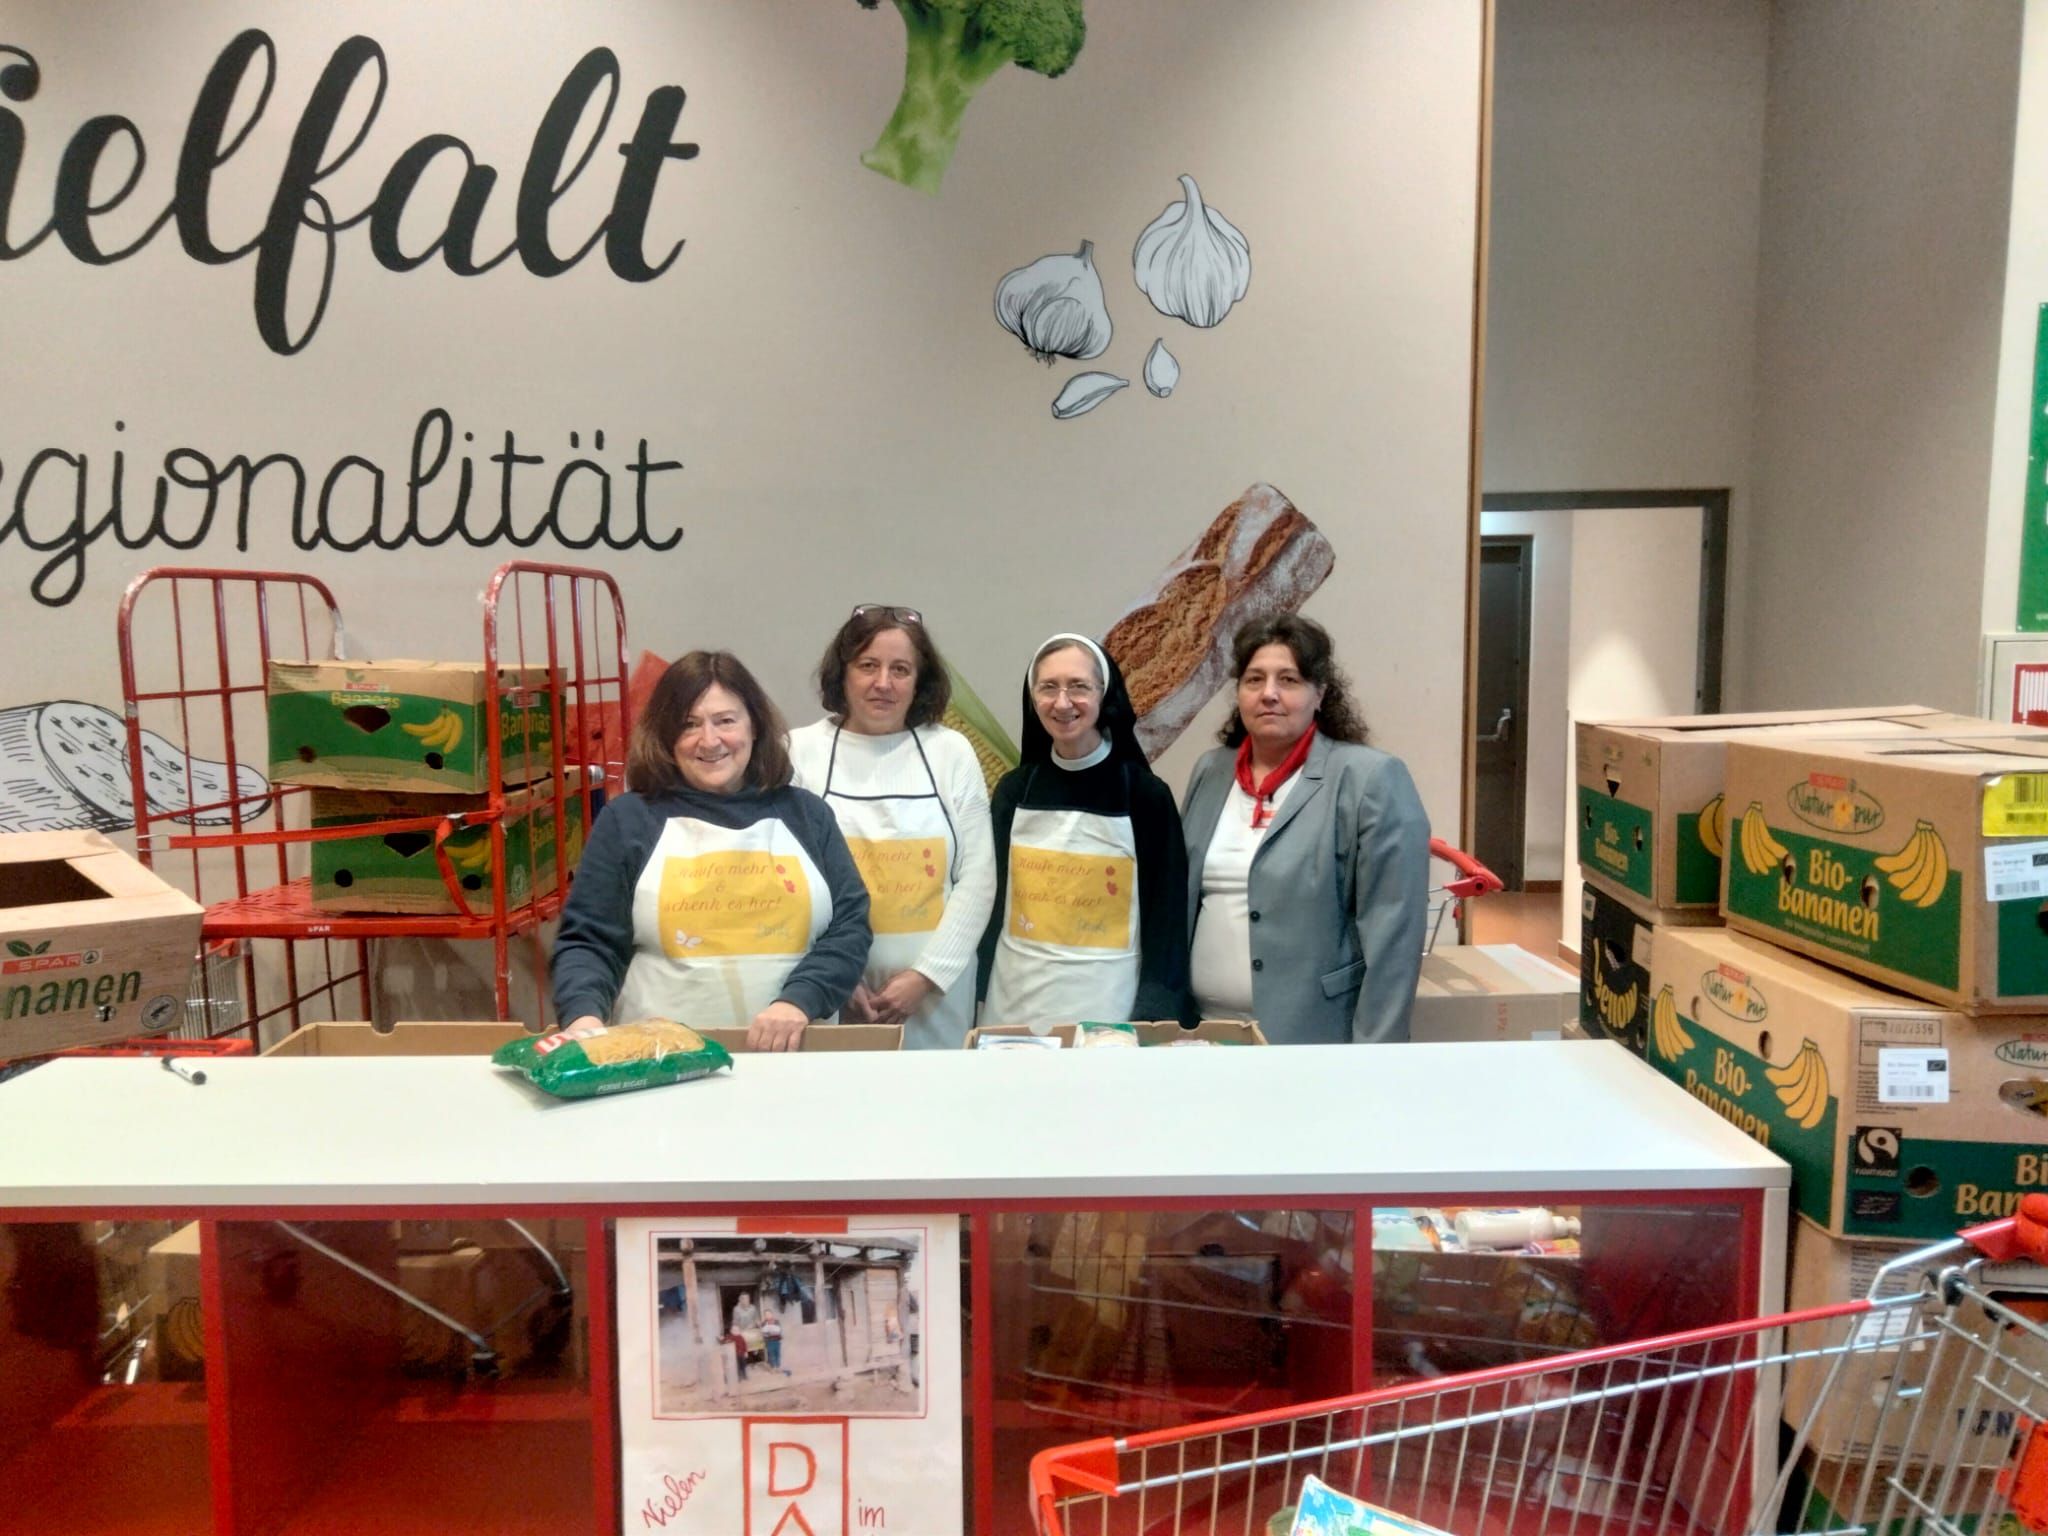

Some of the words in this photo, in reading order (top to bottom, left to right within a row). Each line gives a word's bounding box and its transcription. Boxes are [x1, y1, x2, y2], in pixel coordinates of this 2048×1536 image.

[0, 408, 683, 607] gionalität
[1808, 848, 1853, 892] Bio-
[1777, 876, 1879, 943] Bananen
[18, 954, 81, 973] SPAR
[1714, 1047, 1753, 1097] Bio-
[858, 1498, 886, 1528] im
